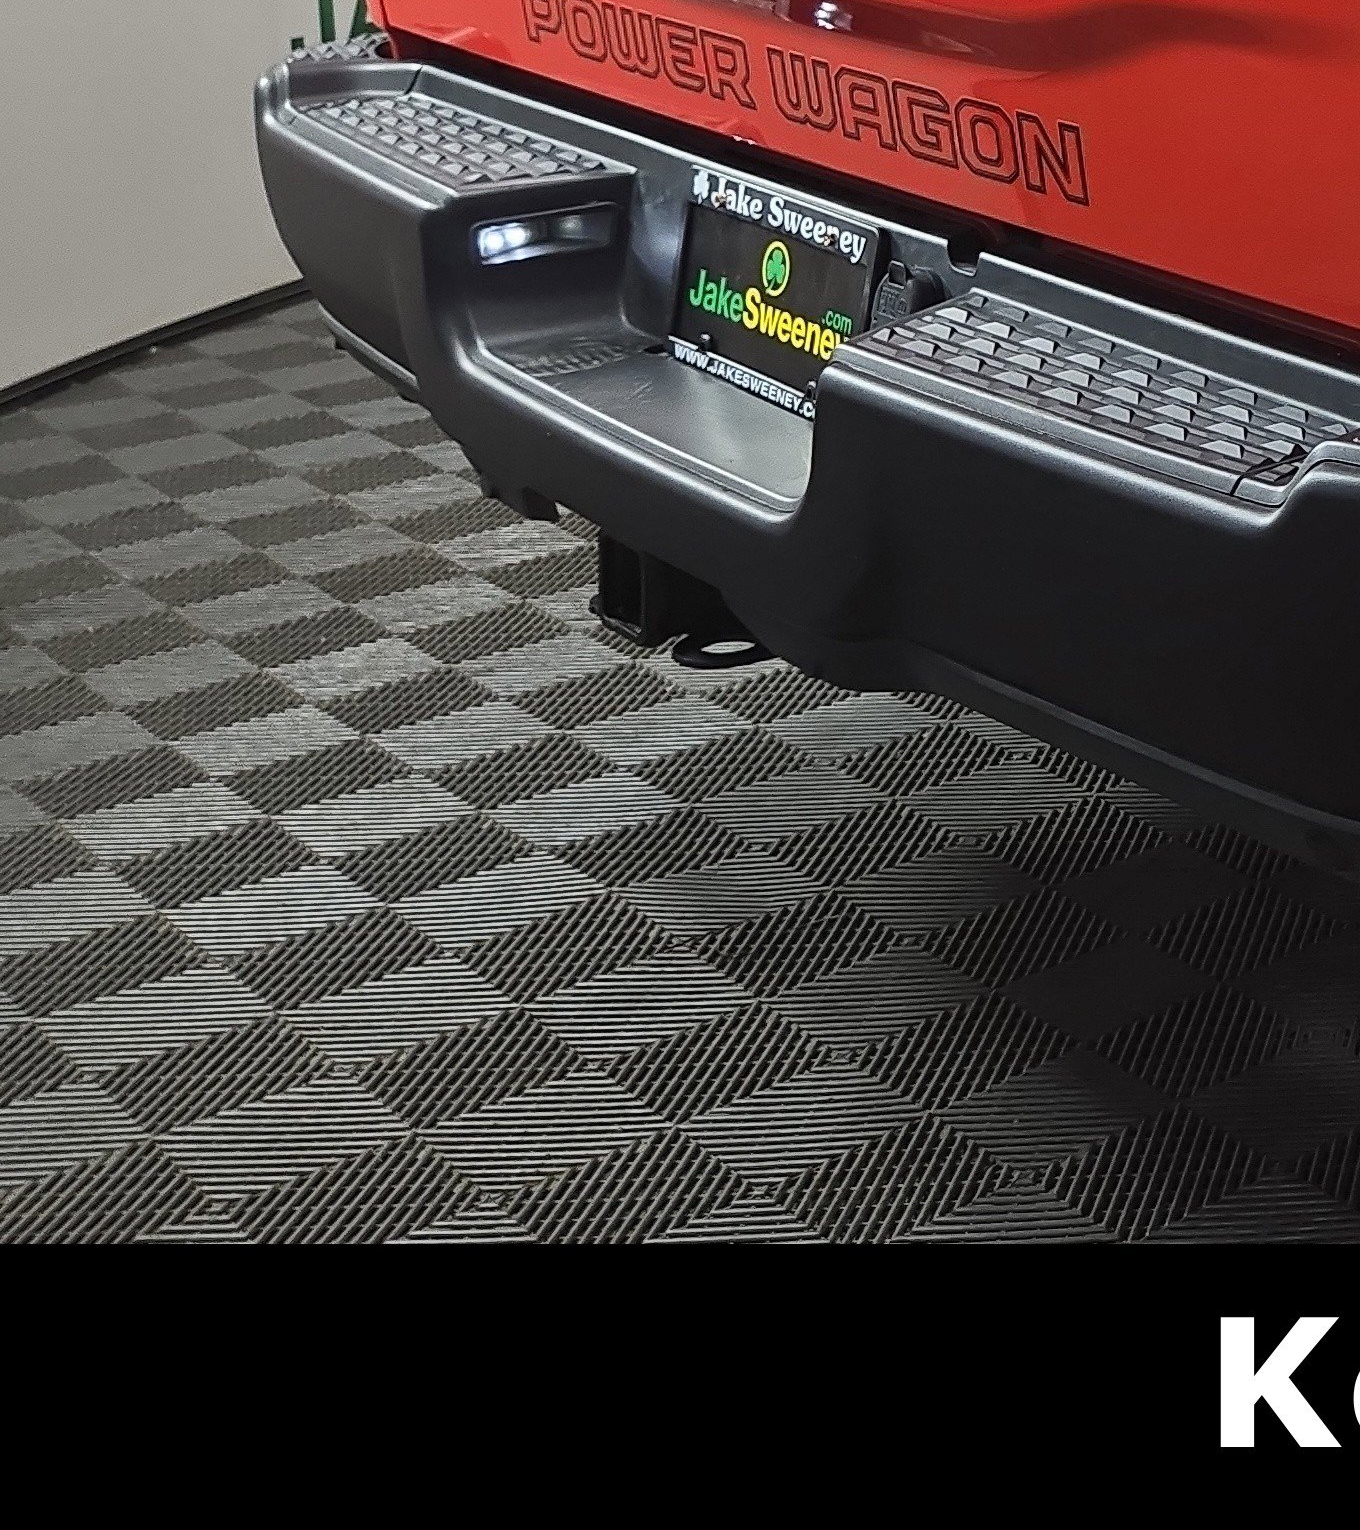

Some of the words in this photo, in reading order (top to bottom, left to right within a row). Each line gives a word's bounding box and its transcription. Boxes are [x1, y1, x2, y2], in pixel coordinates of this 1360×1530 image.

[766, 44, 1091, 207] WAGON
[710, 175, 763, 221] Jake
[767, 196, 867, 264] Sweeney
